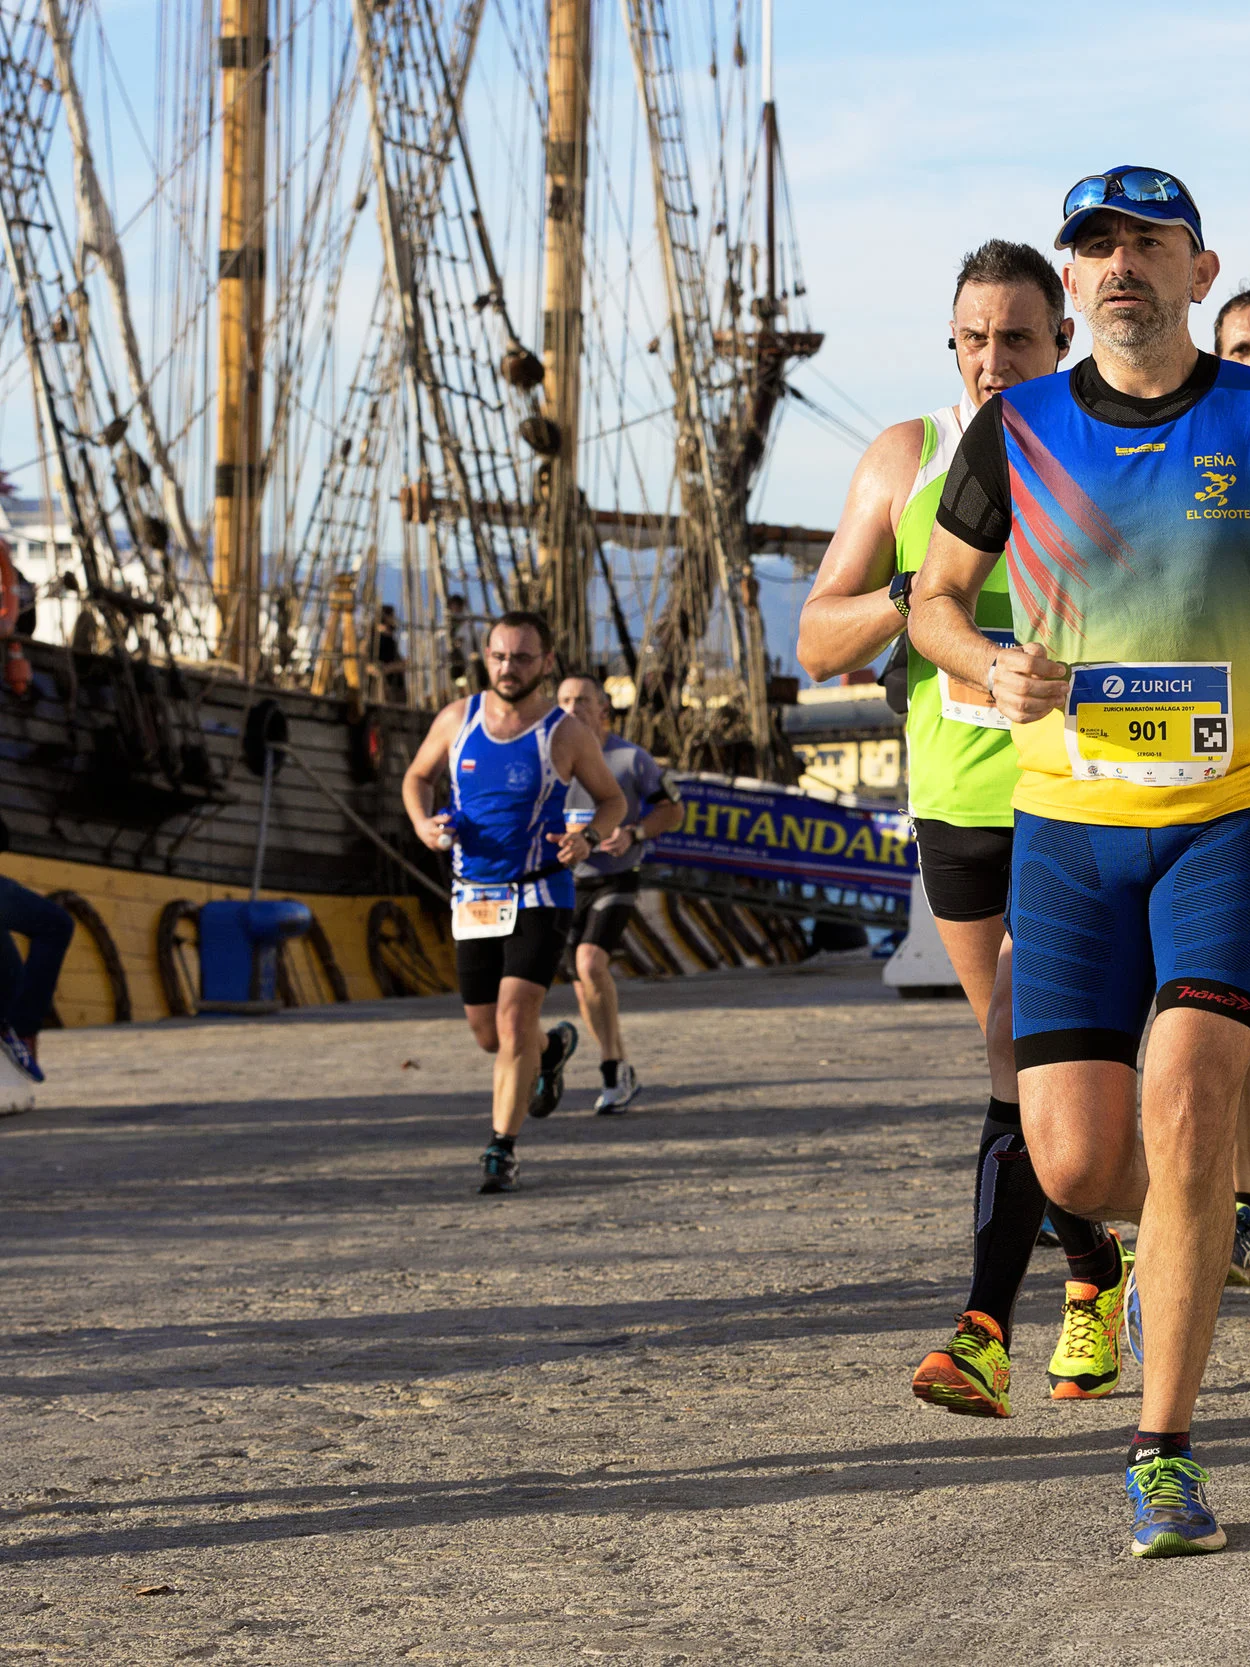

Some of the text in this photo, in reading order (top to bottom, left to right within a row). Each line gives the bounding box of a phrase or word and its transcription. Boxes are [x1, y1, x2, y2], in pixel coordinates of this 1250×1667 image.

[1194, 452, 1237, 467] PEÑA
[1186, 509, 1250, 520] EL COYOTE
[1131, 680, 1192, 693] ZURICH
[1129, 720, 1168, 741] 901
[666, 801, 920, 868] HTANDAR
